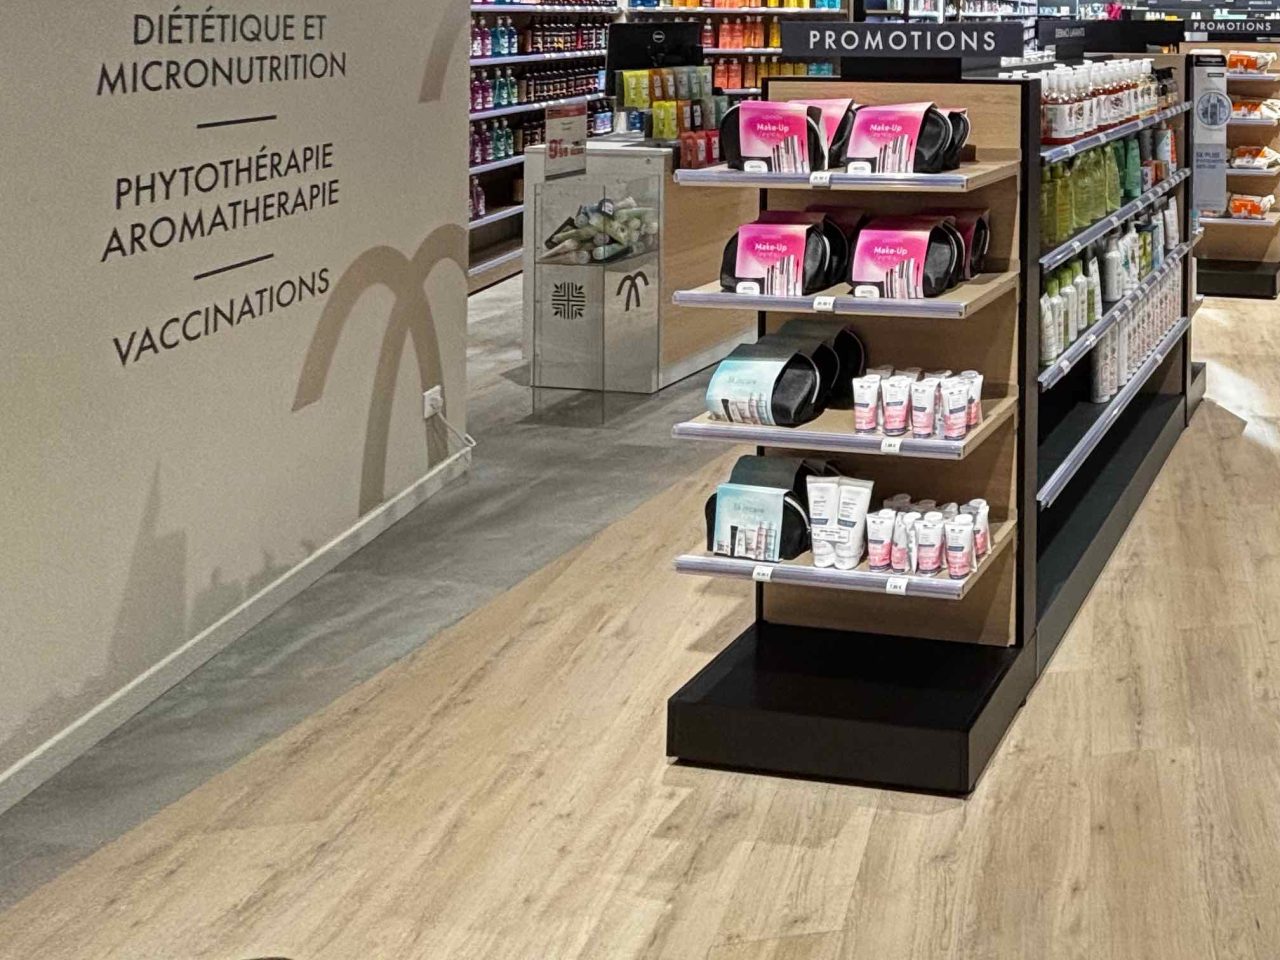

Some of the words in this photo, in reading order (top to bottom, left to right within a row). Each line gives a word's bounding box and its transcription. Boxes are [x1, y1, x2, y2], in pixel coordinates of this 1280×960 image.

[133, 5, 295, 46] DIÉTÉTIQUE
[303, 15, 326, 41] ET
[1193, 22, 1272, 31] PROMOTIONS
[809, 30, 996, 51] PROMOTIONS
[97, 52, 347, 95] MICRONUTRITION
[756, 123, 789, 133] Make-Up
[870, 123, 902, 133] Make-Up
[115, 142, 334, 210] PHYTOTHÉRAPIE
[101, 179, 340, 262] AROMATHERAPIE
[755, 243, 787, 252] Make-Up
[873, 246, 908, 255] Make-Up
[113, 268, 331, 367] VACCINATIONS
